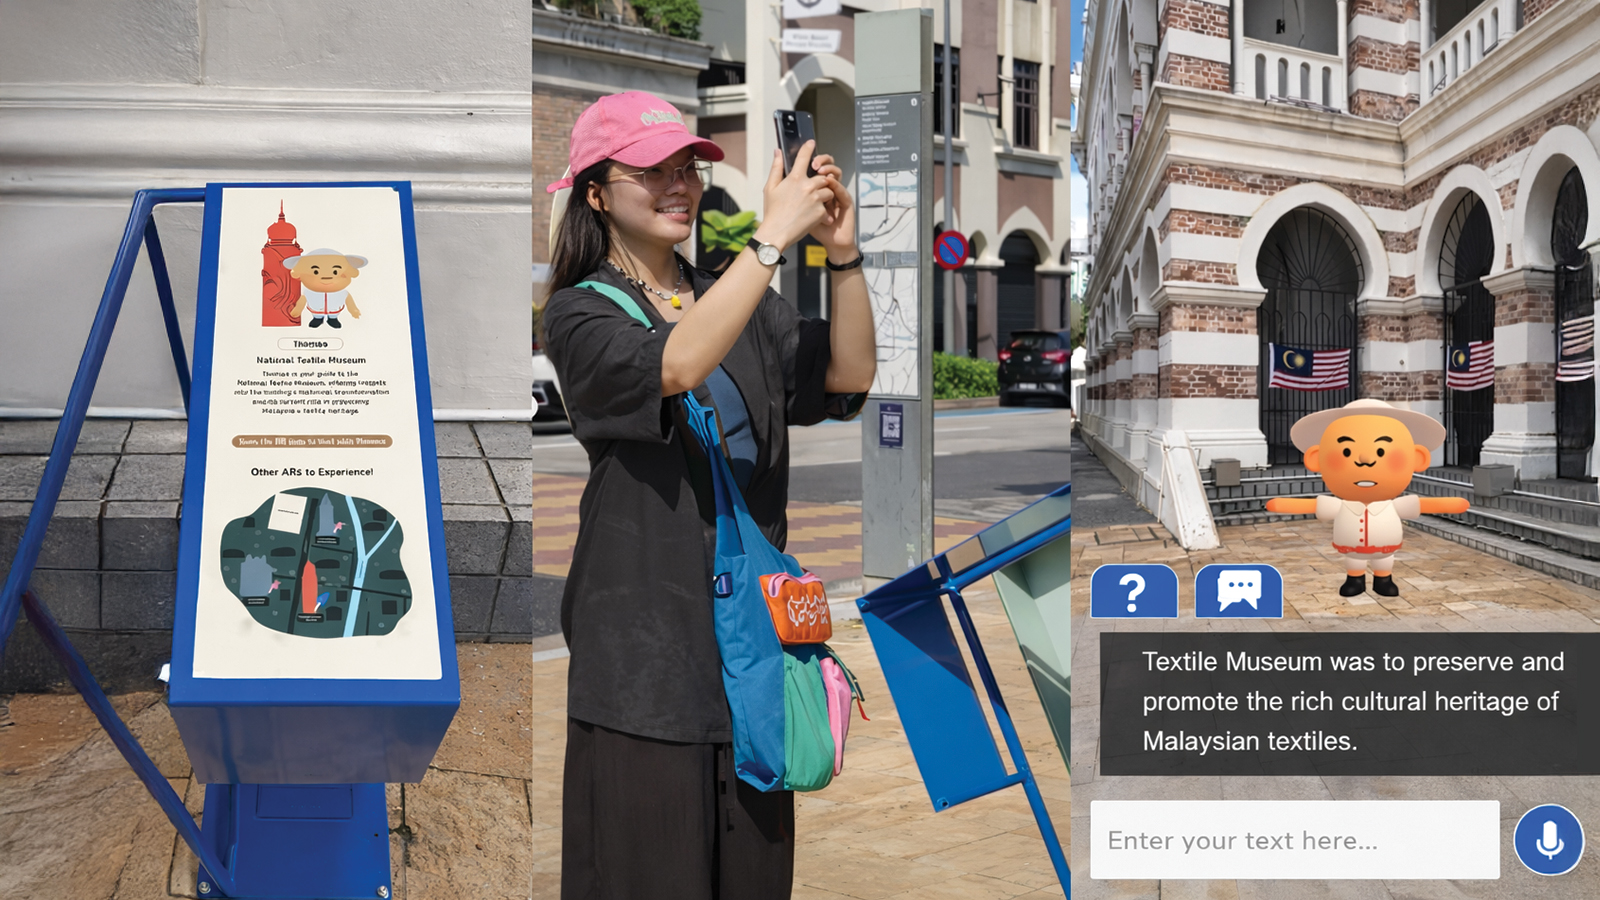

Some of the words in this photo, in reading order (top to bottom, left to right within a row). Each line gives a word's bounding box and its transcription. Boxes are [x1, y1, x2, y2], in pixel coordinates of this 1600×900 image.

[328, 356, 367, 364] Museum
[250, 467, 279, 477] Other
[281, 467, 303, 477] ARs
[305, 468, 316, 477] to
[318, 467, 374, 479] Experience!
[1143, 651, 1217, 671] Textile
[1227, 652, 1321, 671] Museum
[1330, 657, 1374, 670] was
[1383, 653, 1404, 670] to
[1414, 656, 1513, 676] preserve
[1522, 652, 1563, 671] and
[1144, 693, 1238, 716] promote
[1247, 691, 1282, 710] the
[1292, 691, 1332, 710] rich
[1342, 691, 1426, 710] cultural
[1436, 691, 1528, 716] heritage
[1538, 691, 1559, 710] of
[1143, 731, 1259, 755] Malaysian
[1268, 731, 1357, 750] textiles.
[1108, 831, 1174, 850] Enter
[1182, 836, 1237, 855] your
[1245, 833, 1293, 850] text
[1303, 830, 1378, 850] here...
